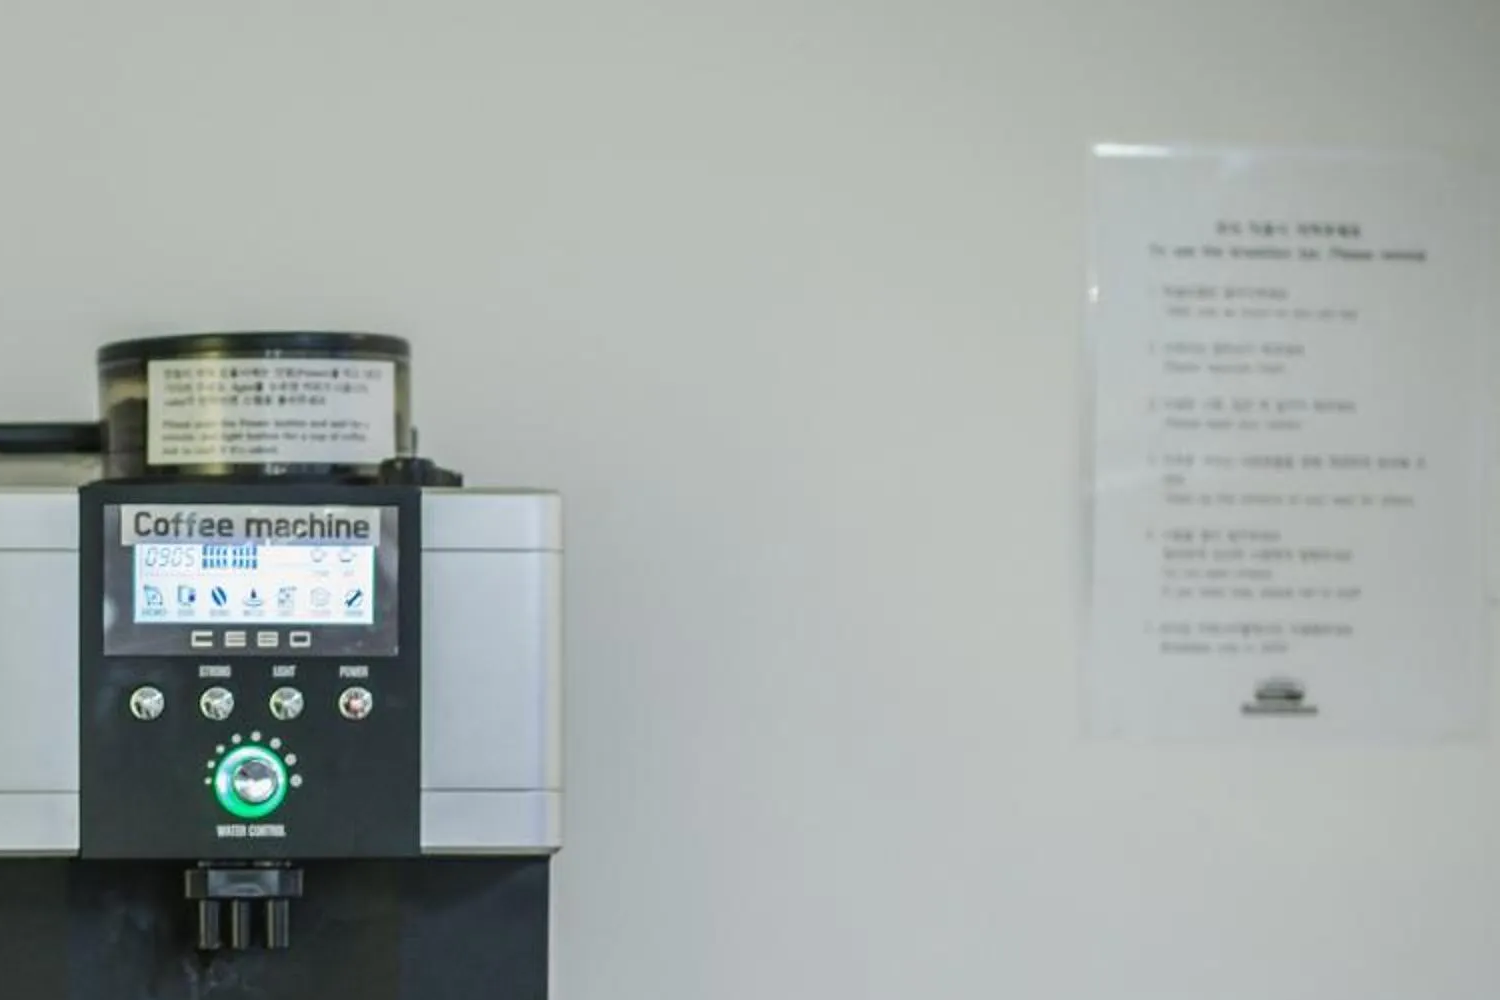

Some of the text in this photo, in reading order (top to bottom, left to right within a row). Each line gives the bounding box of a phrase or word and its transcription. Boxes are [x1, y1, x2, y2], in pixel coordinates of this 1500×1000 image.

[133, 511, 370, 539] Coffee machine
[190, 630, 312, 648] CEBO
